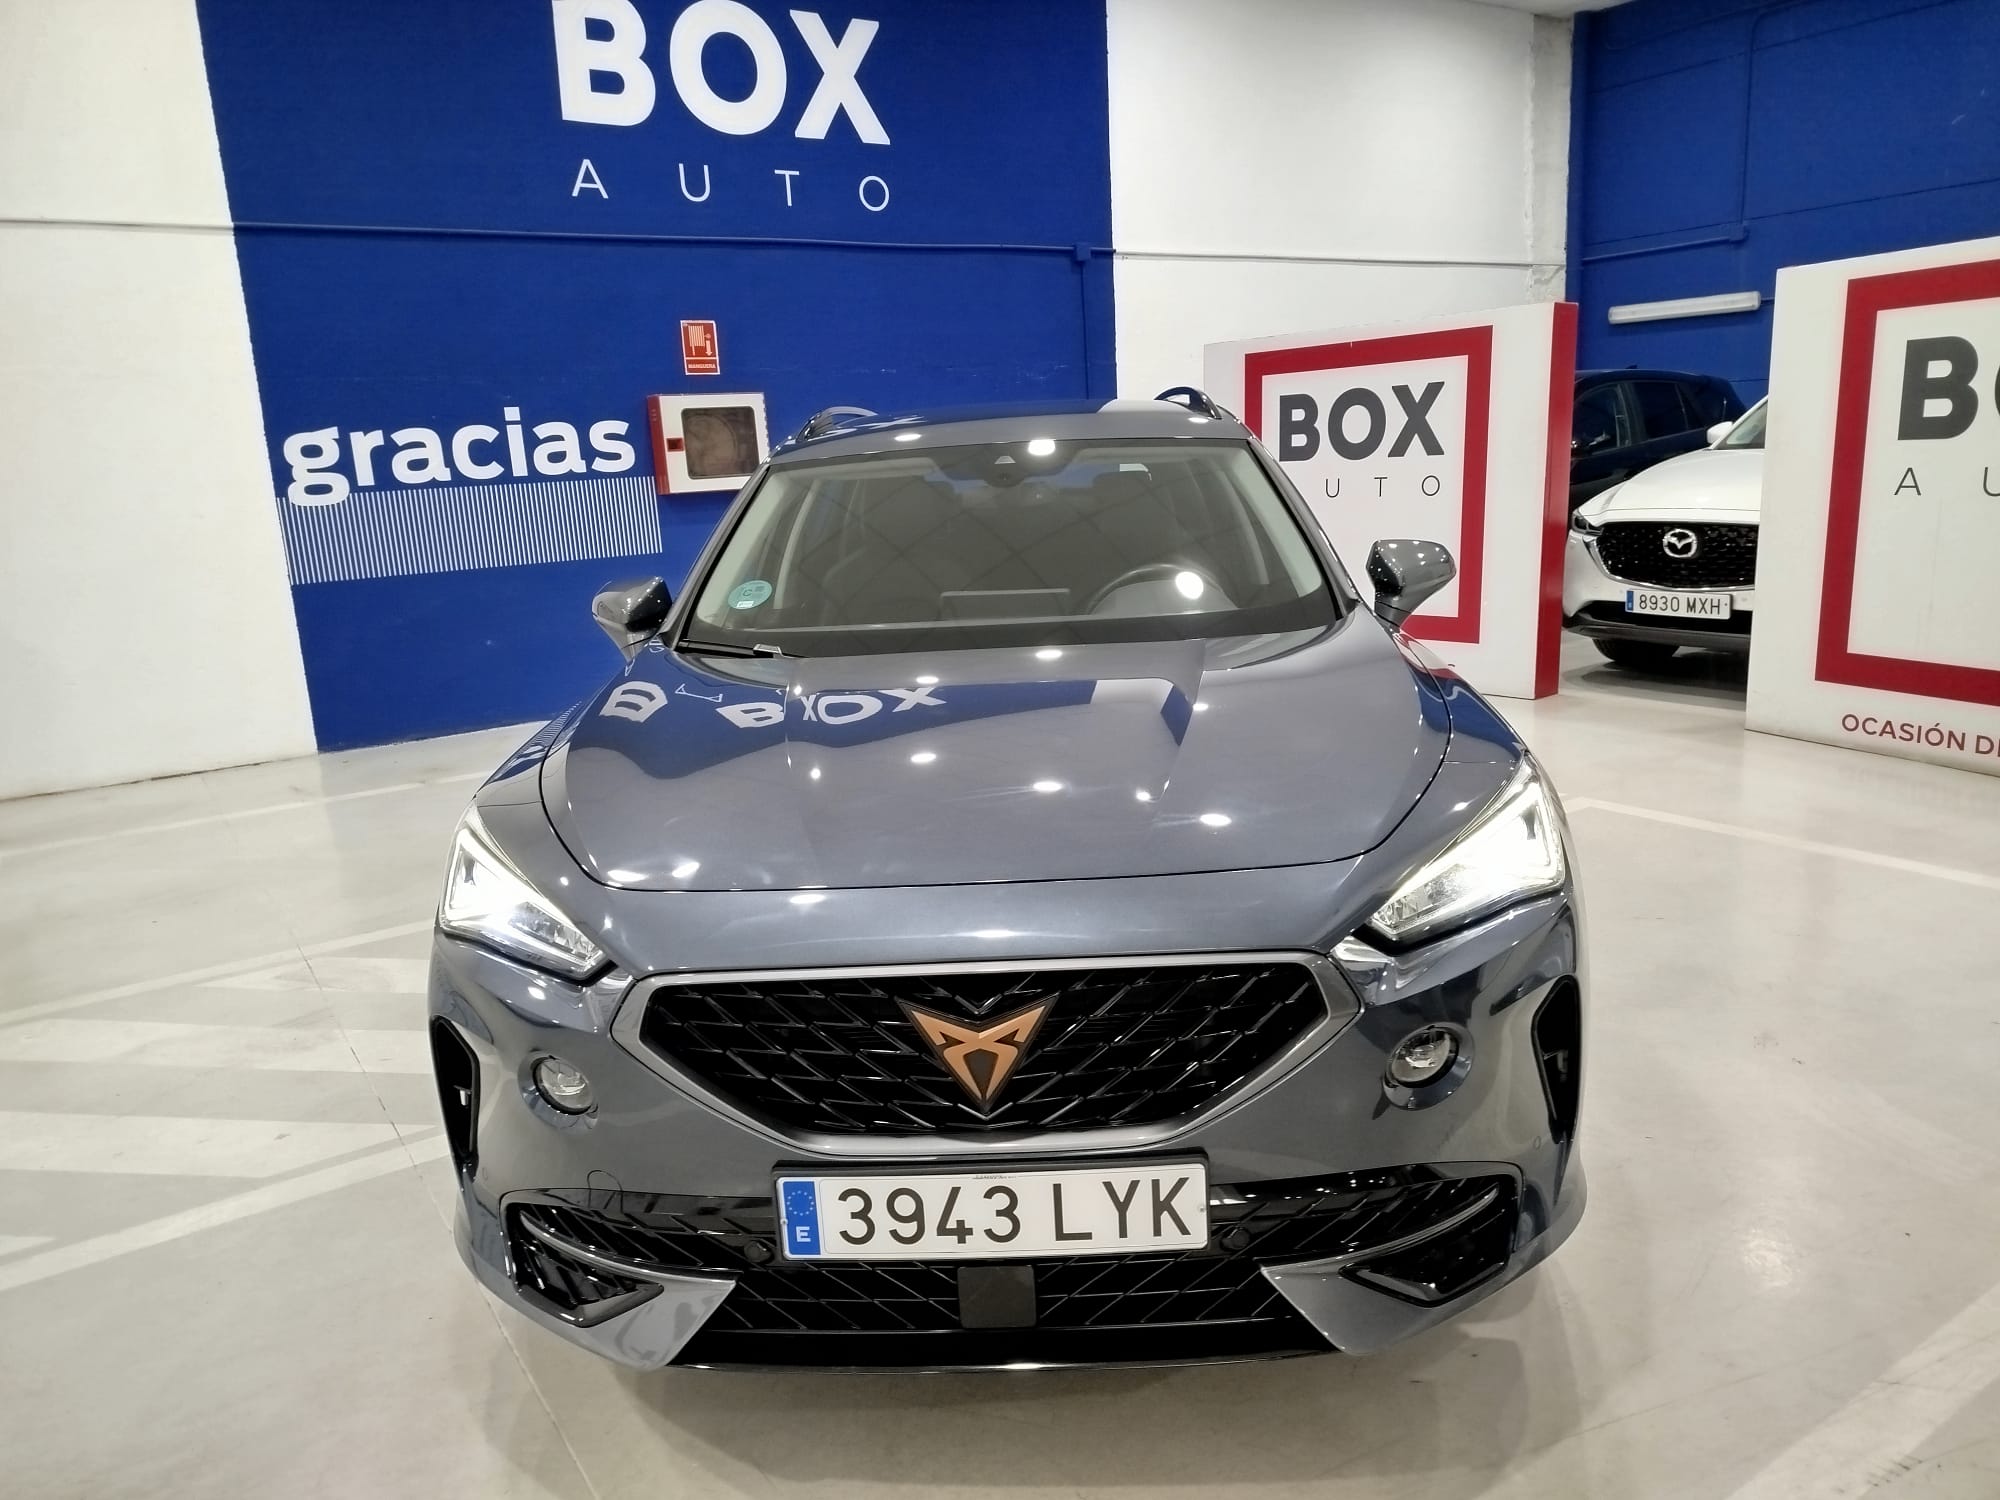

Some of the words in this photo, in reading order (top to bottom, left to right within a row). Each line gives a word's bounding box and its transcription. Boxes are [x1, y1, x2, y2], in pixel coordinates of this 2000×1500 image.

[552, 0, 891, 145] BOX
[571, 159, 890, 212] AUTO
[1279, 381, 1445, 462] BOX
[1898, 336, 2000, 440] B
[283, 406, 636, 506] gracias
[1325, 475, 1441, 498] UTO
[1639, 594, 1680, 612] 8930
[1686, 597, 1721, 615] MXH
[1842, 713, 1966, 751] OCASIÓN
[1975, 735, 2000, 757] D
[796, 1226, 811, 1242] E
[838, 1185, 1021, 1245] 3943
[1052, 1176, 1191, 1241] LYK
